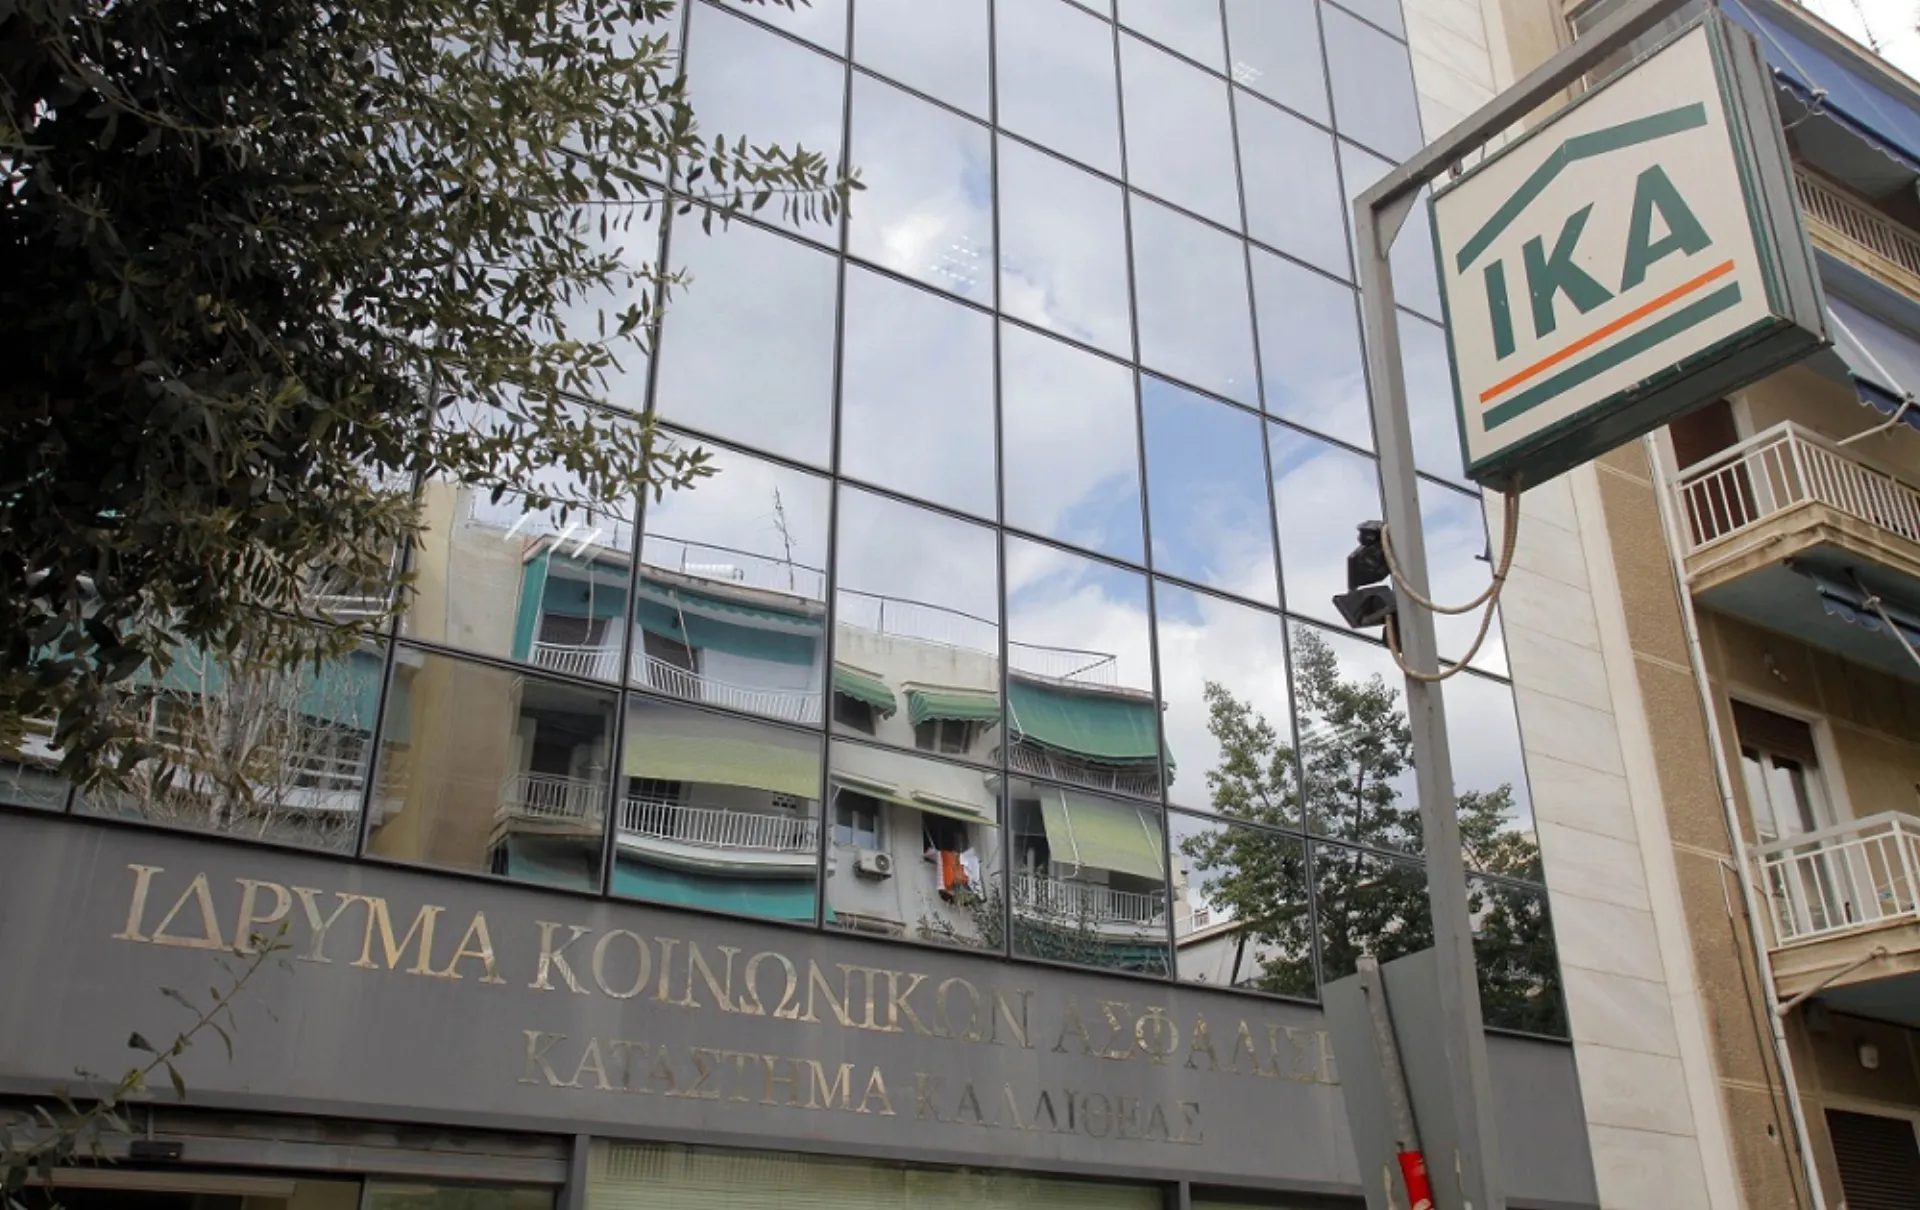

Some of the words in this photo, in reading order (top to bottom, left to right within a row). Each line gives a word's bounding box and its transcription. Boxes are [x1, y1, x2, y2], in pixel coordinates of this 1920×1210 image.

[1484, 164, 1713, 361] ΙΚΑ
[112, 864, 507, 984] ΙΔΡΥΜΑ
[528, 920, 1034, 1049] ΚΟΙΝΩΝΙΚΩΝ
[517, 1029, 897, 1116] ΚΑΤΑΣΤΗΜΑ
[914, 1072, 1203, 1145] ΚΑΛΛΙΘΕΑΣ
